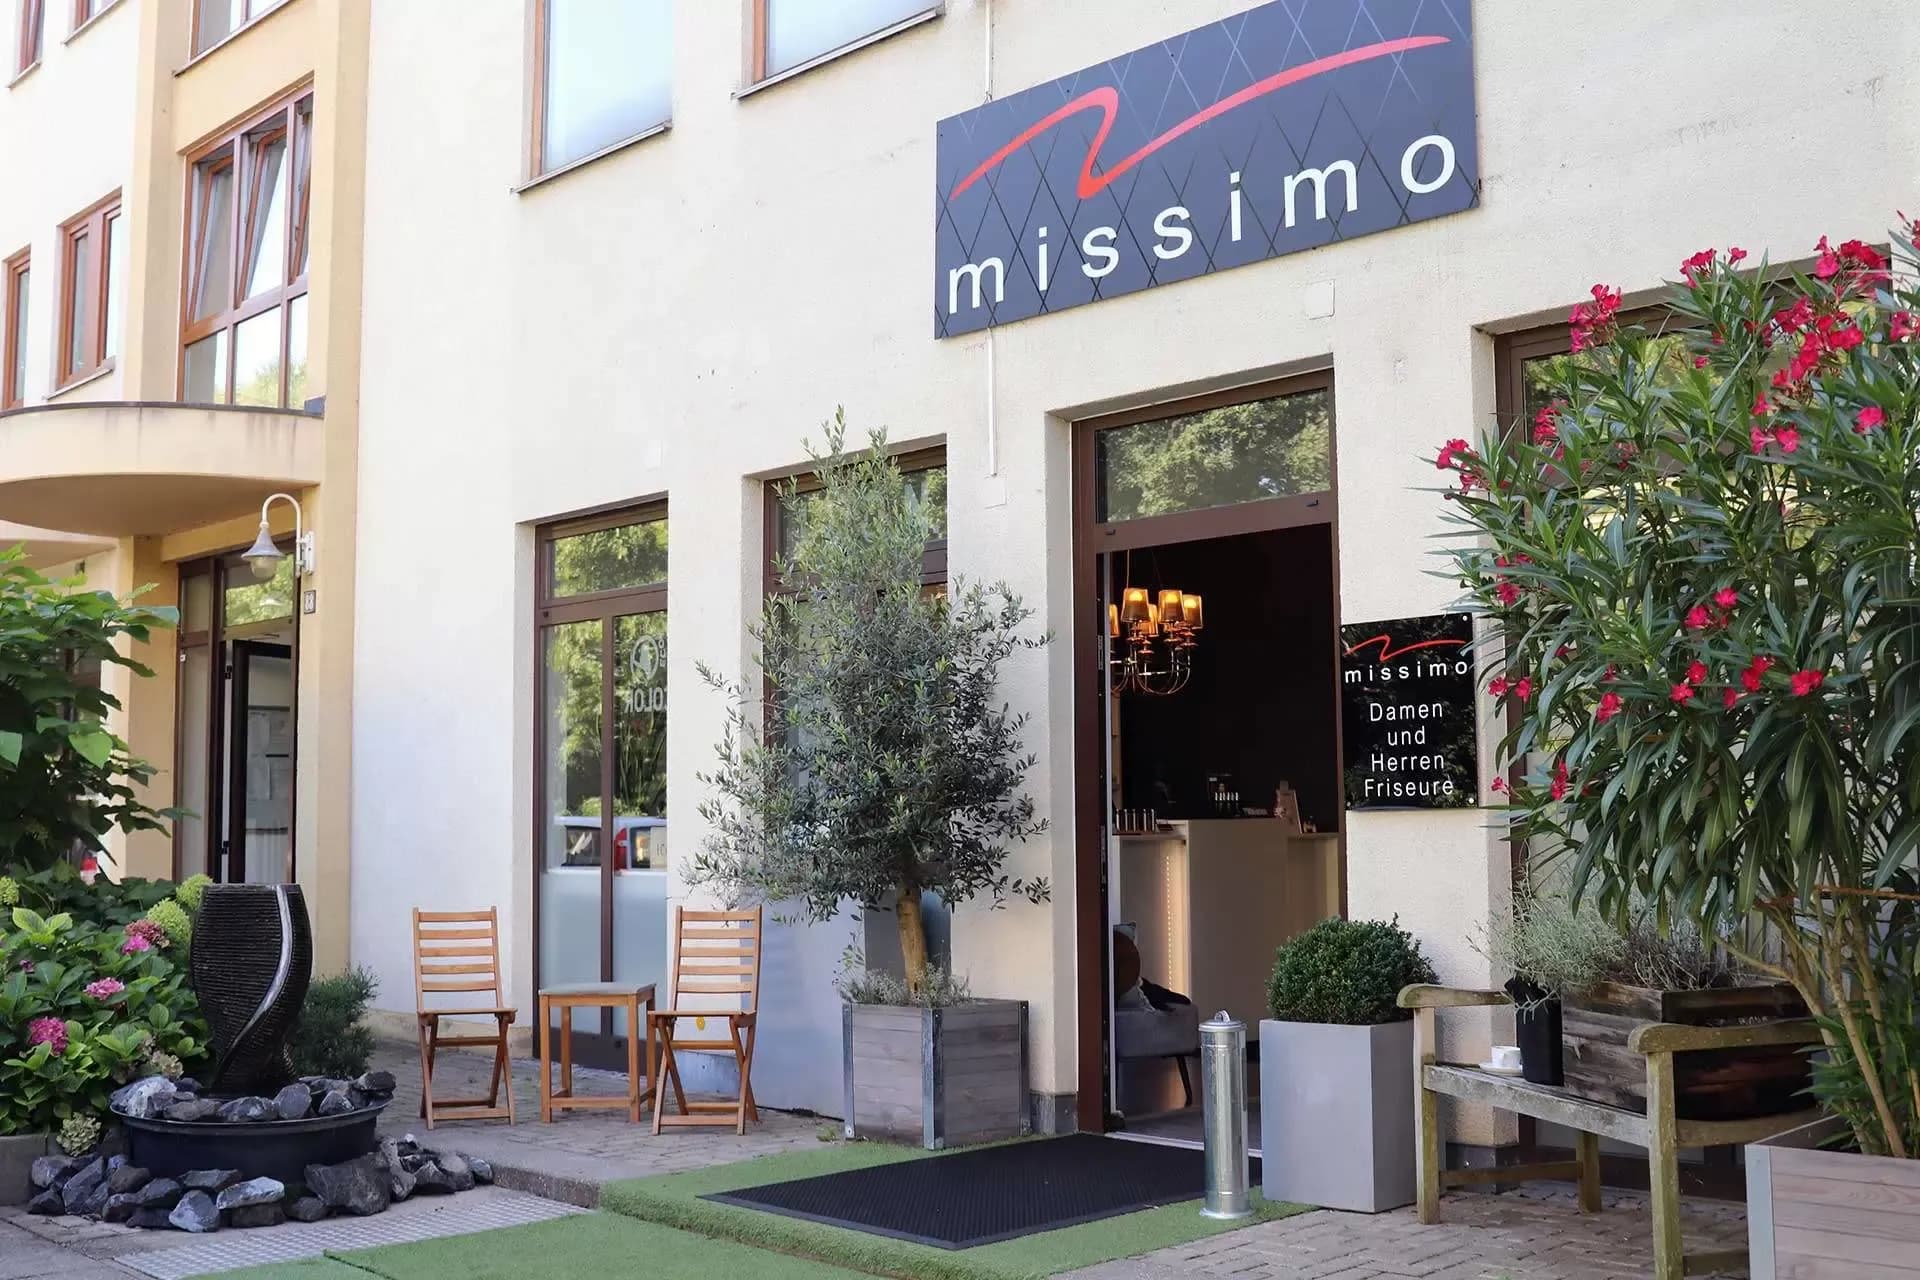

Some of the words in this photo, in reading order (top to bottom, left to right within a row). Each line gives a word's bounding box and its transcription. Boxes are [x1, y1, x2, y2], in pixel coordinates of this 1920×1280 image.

[948, 134, 1456, 314] missimo
[1344, 661, 1468, 683] missimo
[1370, 702, 1444, 722] Damen
[1387, 725, 1426, 746] und
[1371, 753, 1445, 773] Herren
[1364, 778, 1454, 798] Friseure
